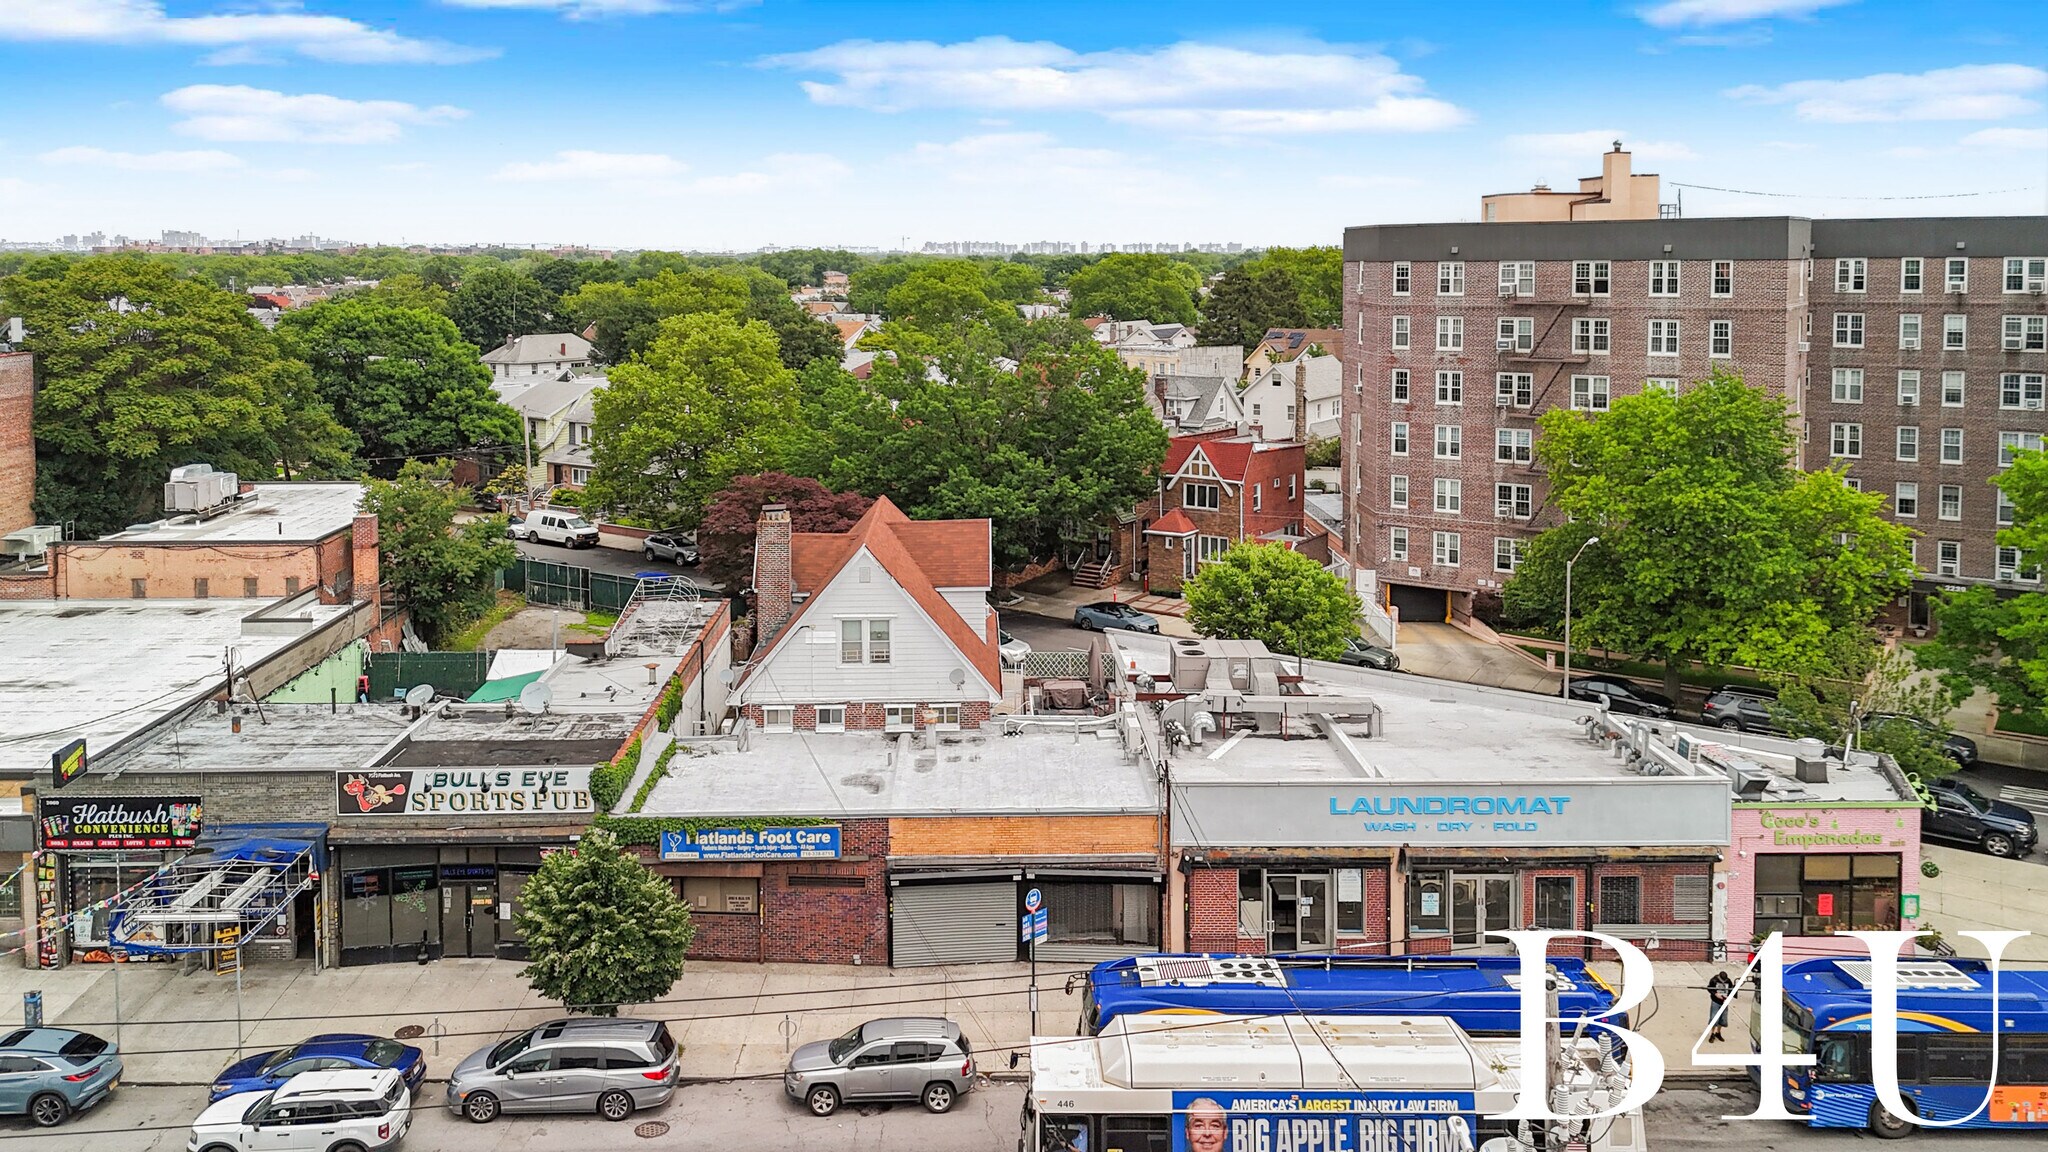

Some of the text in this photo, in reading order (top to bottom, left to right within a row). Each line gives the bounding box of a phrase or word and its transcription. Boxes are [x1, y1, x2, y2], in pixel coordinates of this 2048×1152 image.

[432, 770, 569, 788] BULLS EYE
[411, 789, 591, 812] SPORTS PUB
[1329, 796, 1571, 816] LAUNDROMAT
[72, 803, 171, 824] Flatbush
[1761, 810, 1820, 829] Coco's
[74, 824, 169, 834] CONVENIENCE
[1364, 822, 1538, 832] WASH DRY FOLD
[759, 830, 792, 844] Foot
[795, 830, 831, 844] Care
[1774, 829, 1883, 850] Empanadas
[702, 851, 798, 859] www.FlatlandsFootCare.com
[1057, 1100, 1075, 1108] 446
[1231, 1098, 1458, 1112] AMERICA'S LARGEST INJURY LAW FIRM
[1232, 1118, 1270, 1152] BIG
[1359, 1118, 1397, 1152] BIG
